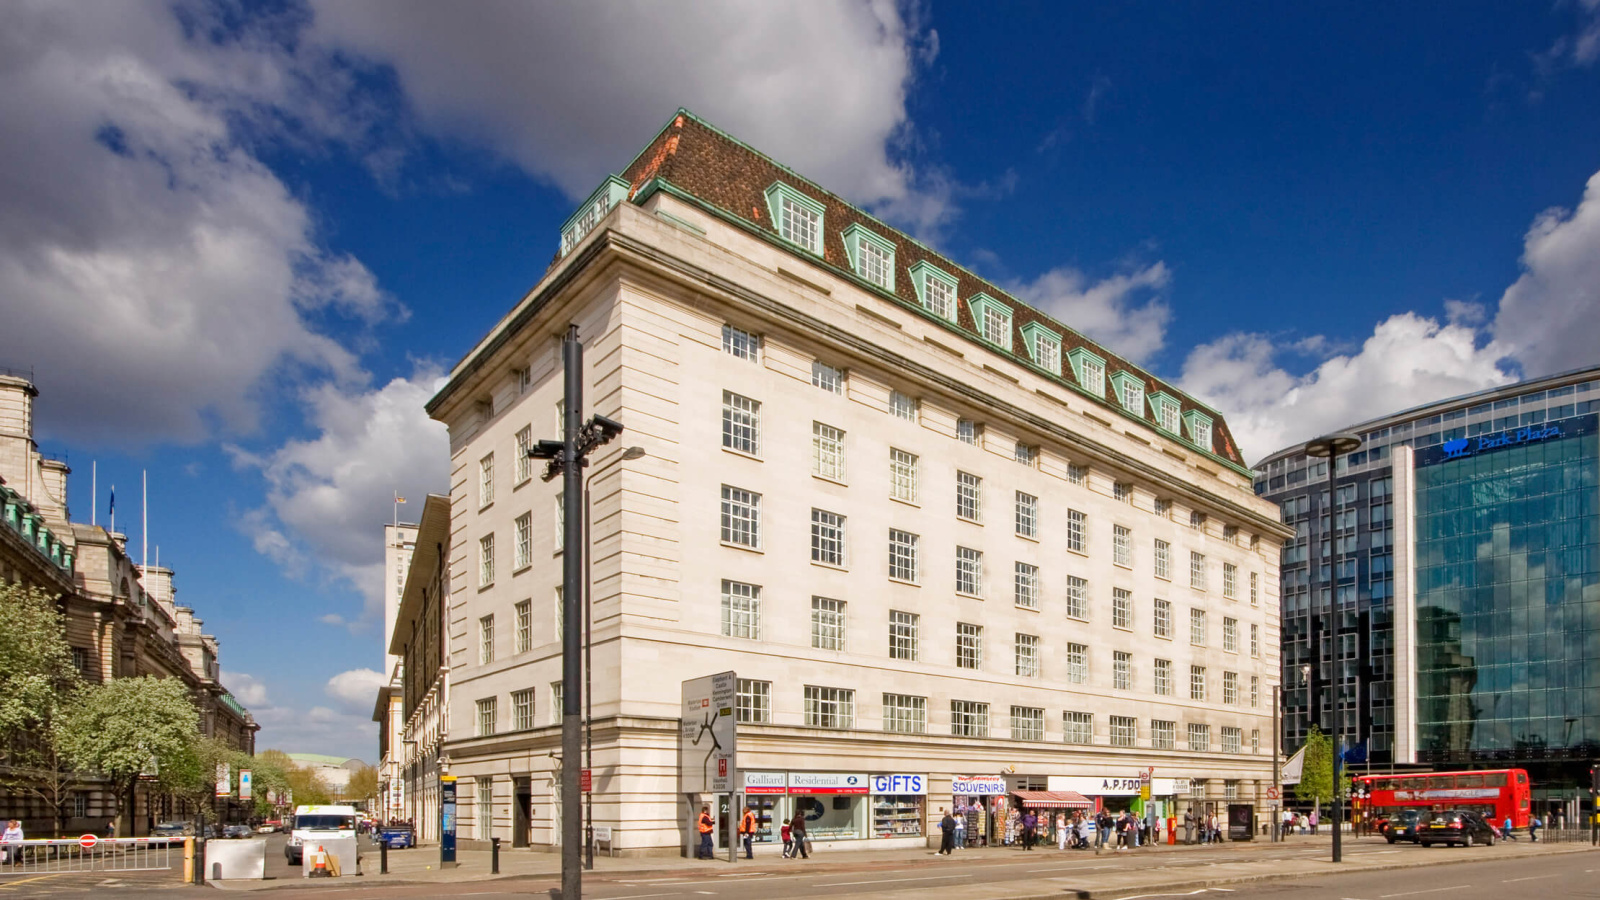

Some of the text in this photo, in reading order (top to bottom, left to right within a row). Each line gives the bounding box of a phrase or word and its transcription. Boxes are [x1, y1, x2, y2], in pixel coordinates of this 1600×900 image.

[1478, 426, 1559, 449] Park Plaza
[747, 774, 839, 785] Galliard Residential
[875, 775, 921, 792] GIFTS
[952, 782, 1005, 793] SOUVENIRS
